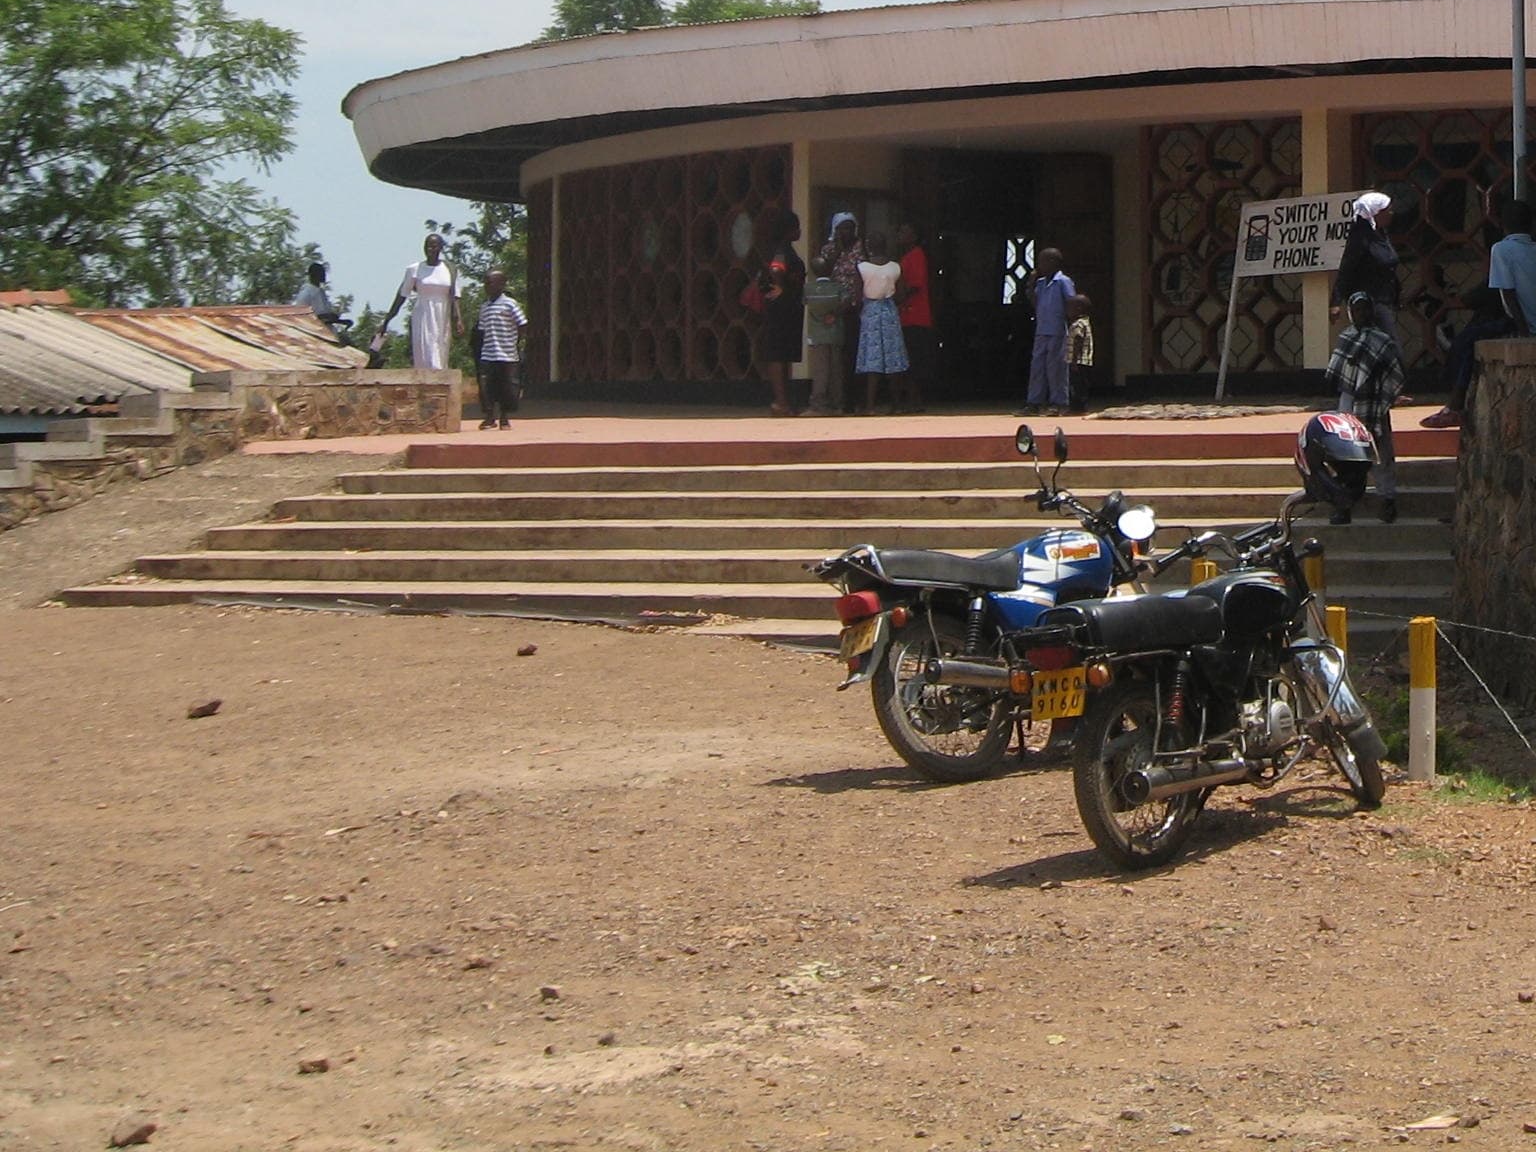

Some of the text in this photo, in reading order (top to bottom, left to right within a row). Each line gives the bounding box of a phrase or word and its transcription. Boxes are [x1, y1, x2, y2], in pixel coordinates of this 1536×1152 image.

[1274, 202, 1328, 225] SWITCH
[1279, 225, 1318, 245] YOUR
[1273, 247, 1325, 268] PHONE.
